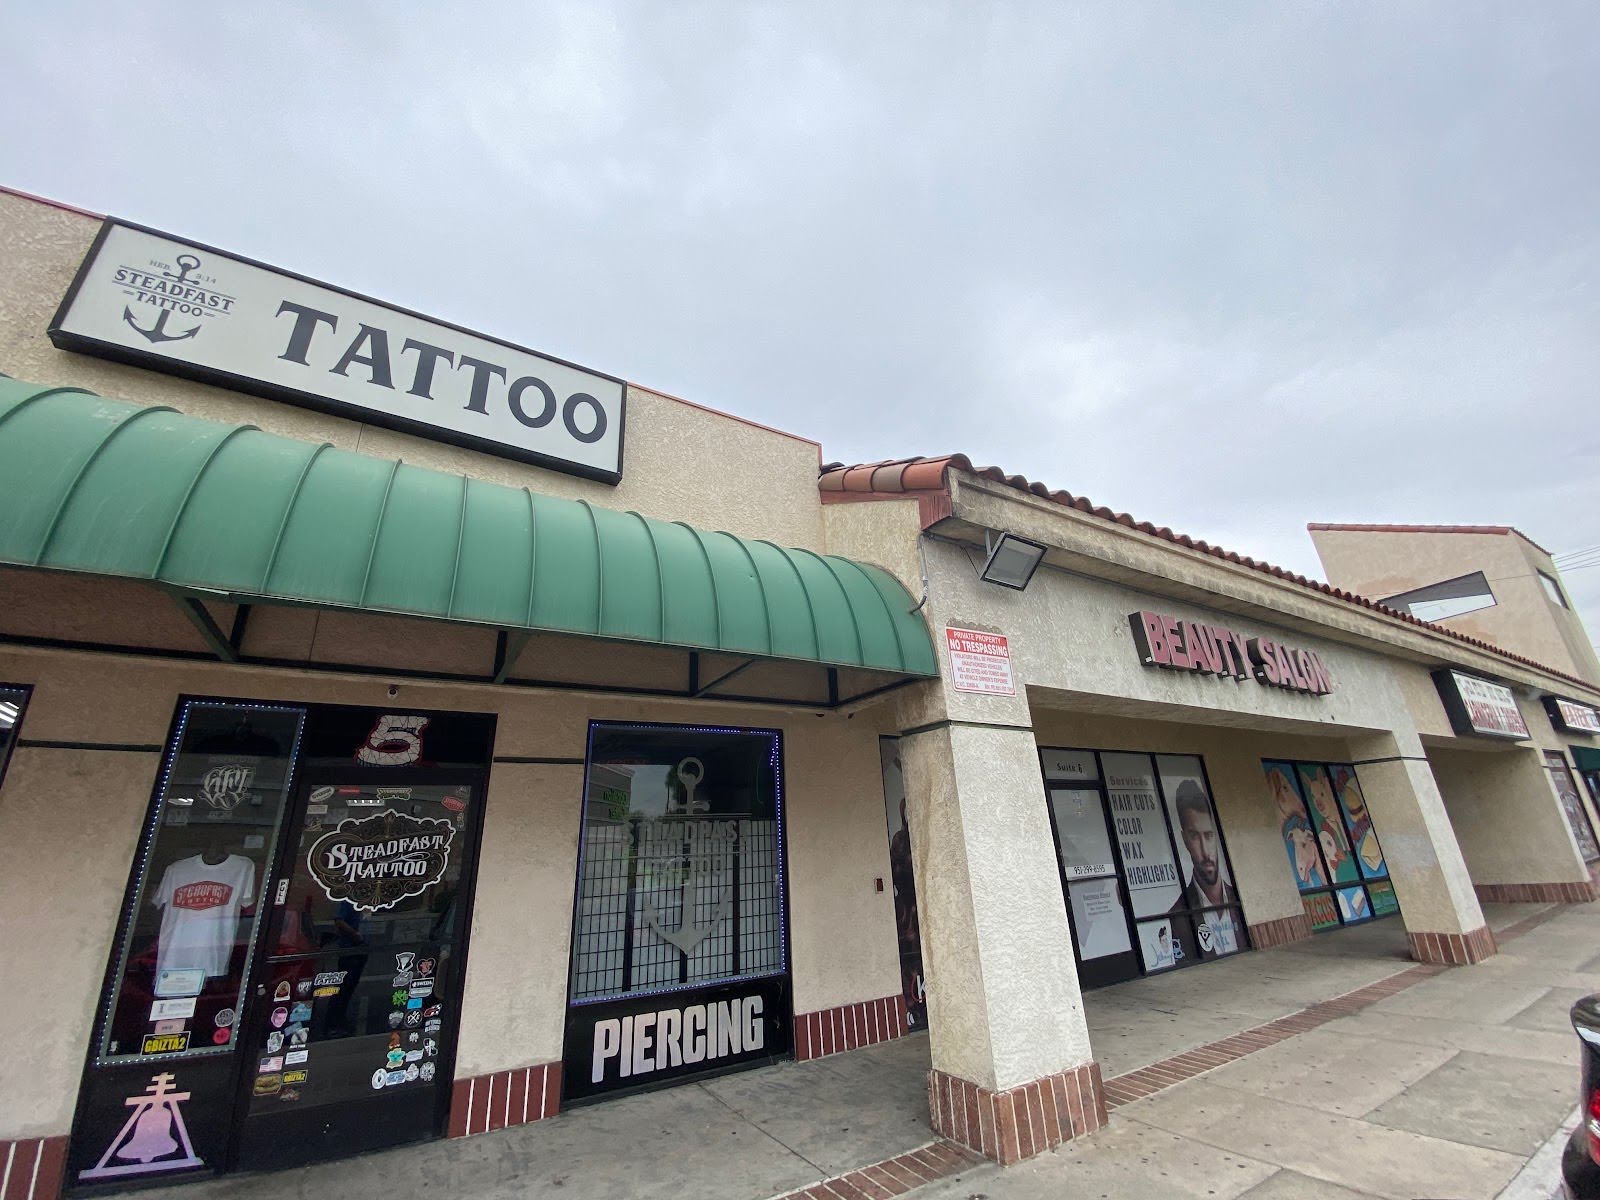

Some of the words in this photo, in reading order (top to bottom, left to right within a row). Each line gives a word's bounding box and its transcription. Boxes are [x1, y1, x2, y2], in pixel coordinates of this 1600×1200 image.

[114, 269, 234, 311] STEADFAST
[136, 290, 203, 317] TATTOO
[275, 300, 608, 444] TATTOO
[949, 639, 960, 651] NO
[961, 640, 1008, 657] TRESPASSING
[953, 631, 975, 641] PRIVATE
[975, 634, 1001, 645] PROPERTY
[1138, 611, 1254, 679] BEAUTY
[1256, 636, 1333, 694] SALON
[356, 714, 430, 767] 5
[1056, 762, 1076, 772] Suite
[1109, 775, 1149, 786] Services
[1111, 793, 1133, 811] HAIR
[1133, 793, 1156, 811] CUTS
[1116, 817, 1144, 835] COLOR
[325, 835, 443, 869] STEADFAST
[1121, 841, 1145, 860] WAX
[343, 861, 427, 883] TATTOO
[1126, 863, 1176, 886] HIGHLIGHTS
[144, 1037, 187, 1053] GBIZTA2
[592, 995, 764, 1084] PIERCING
